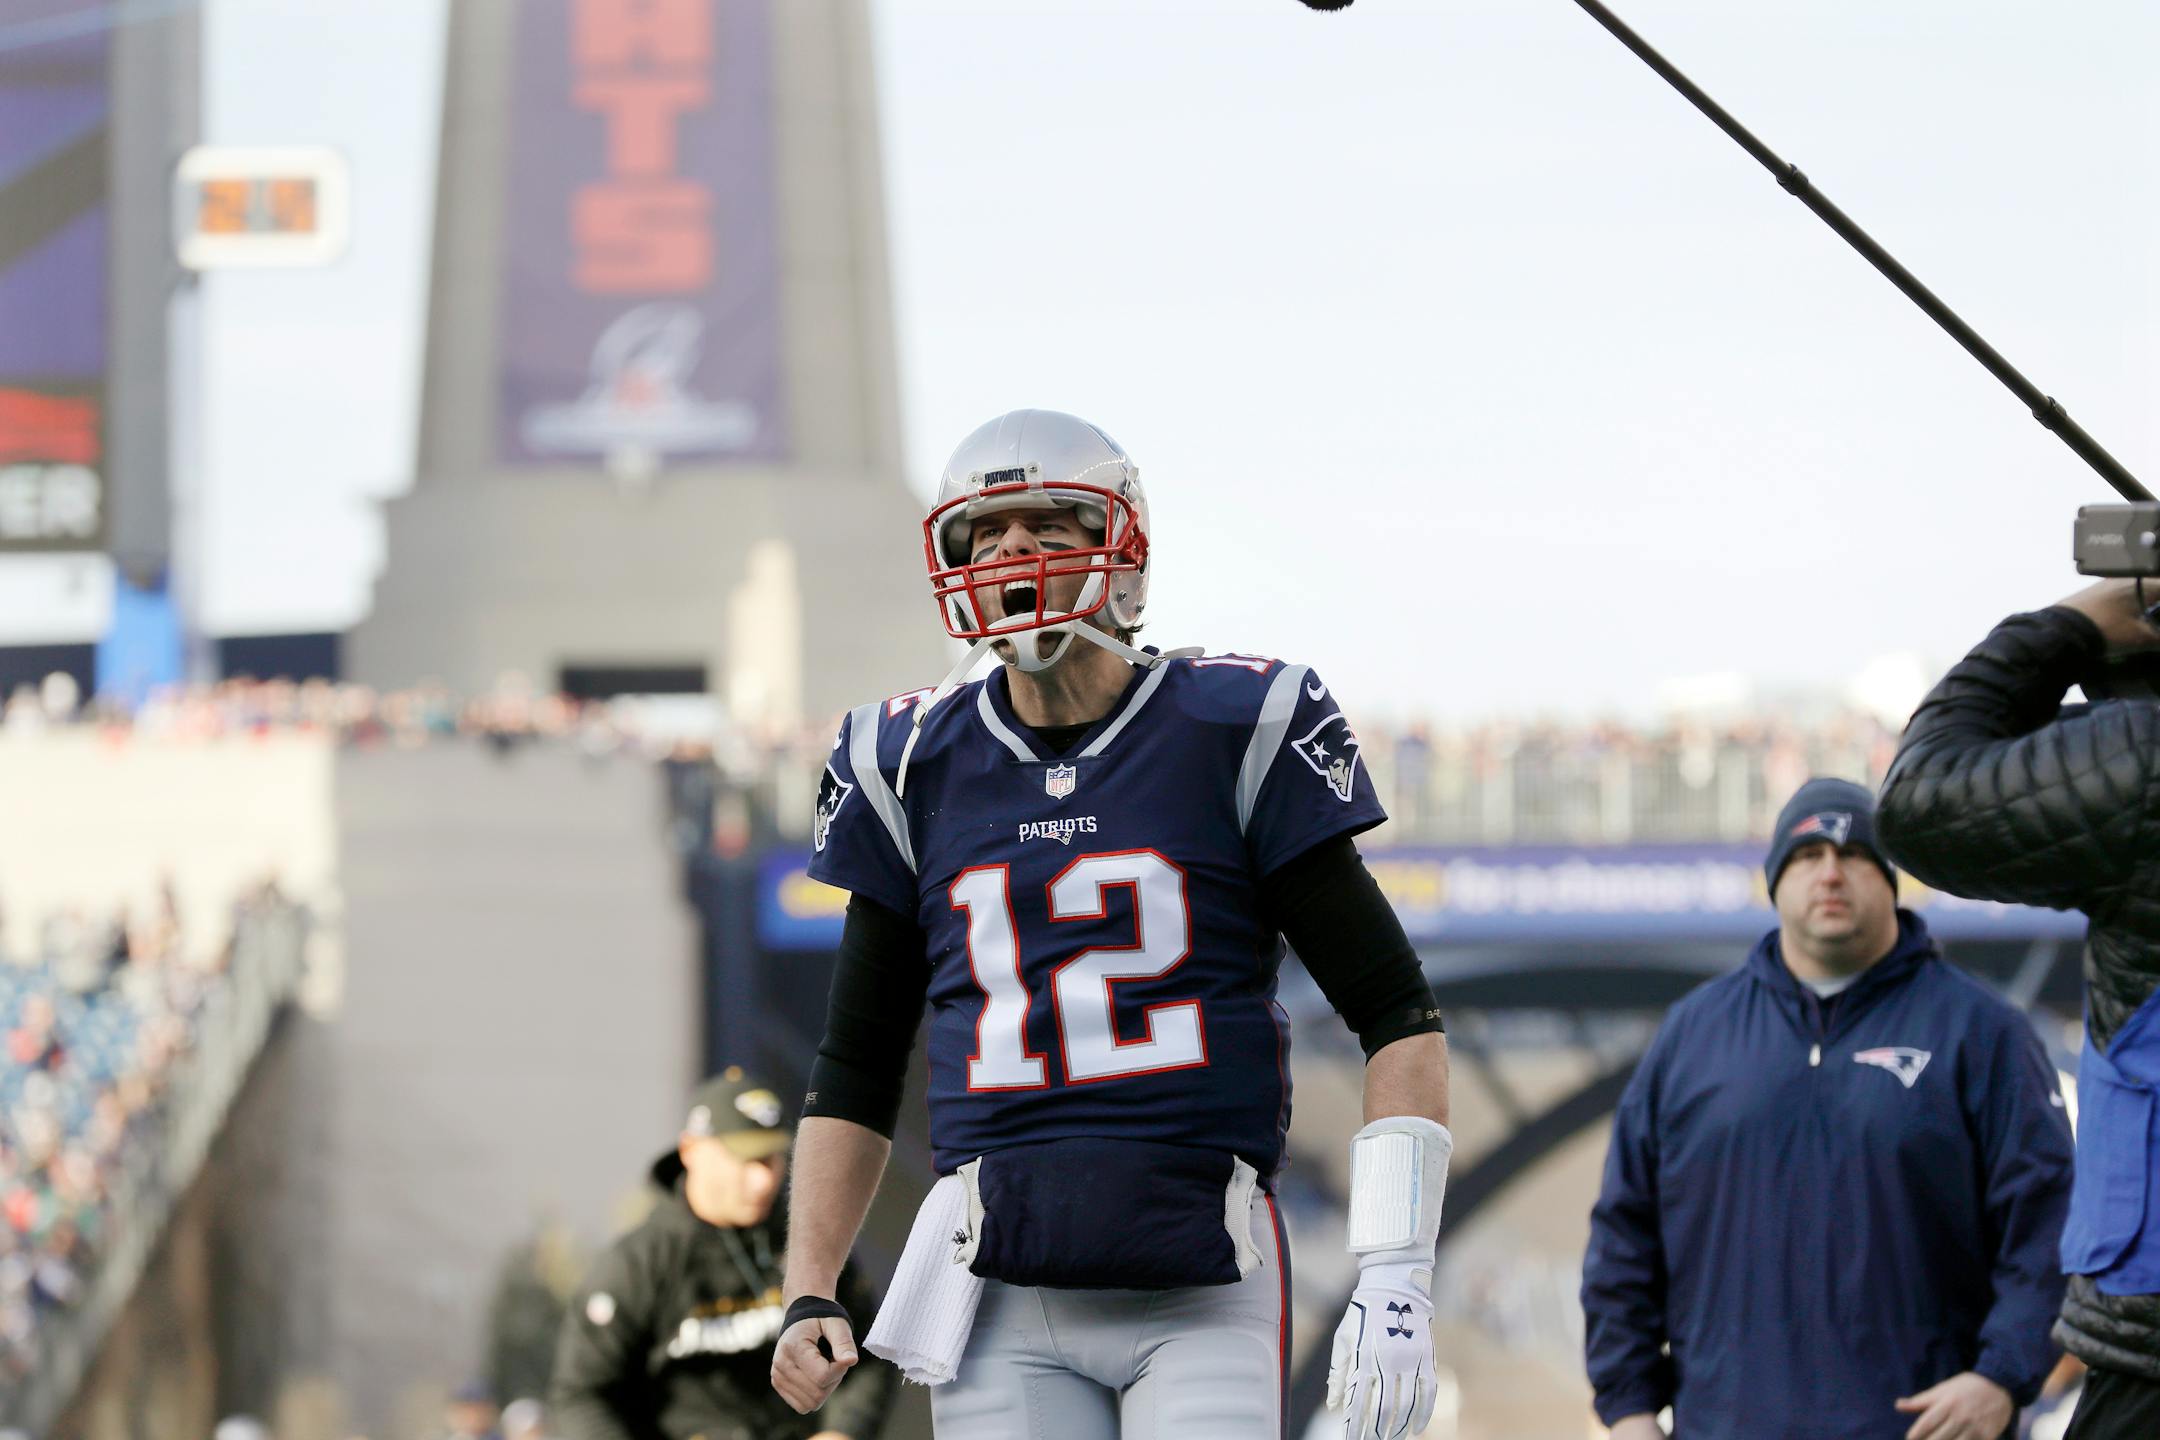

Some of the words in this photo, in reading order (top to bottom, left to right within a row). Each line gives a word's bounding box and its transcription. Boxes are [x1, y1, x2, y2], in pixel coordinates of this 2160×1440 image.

[984, 467, 1026, 488] PATRIOTS
[1050, 778, 1072, 793] NFL
[1018, 815, 1098, 843] PATRIOTS
[948, 847, 1210, 1093] 12
